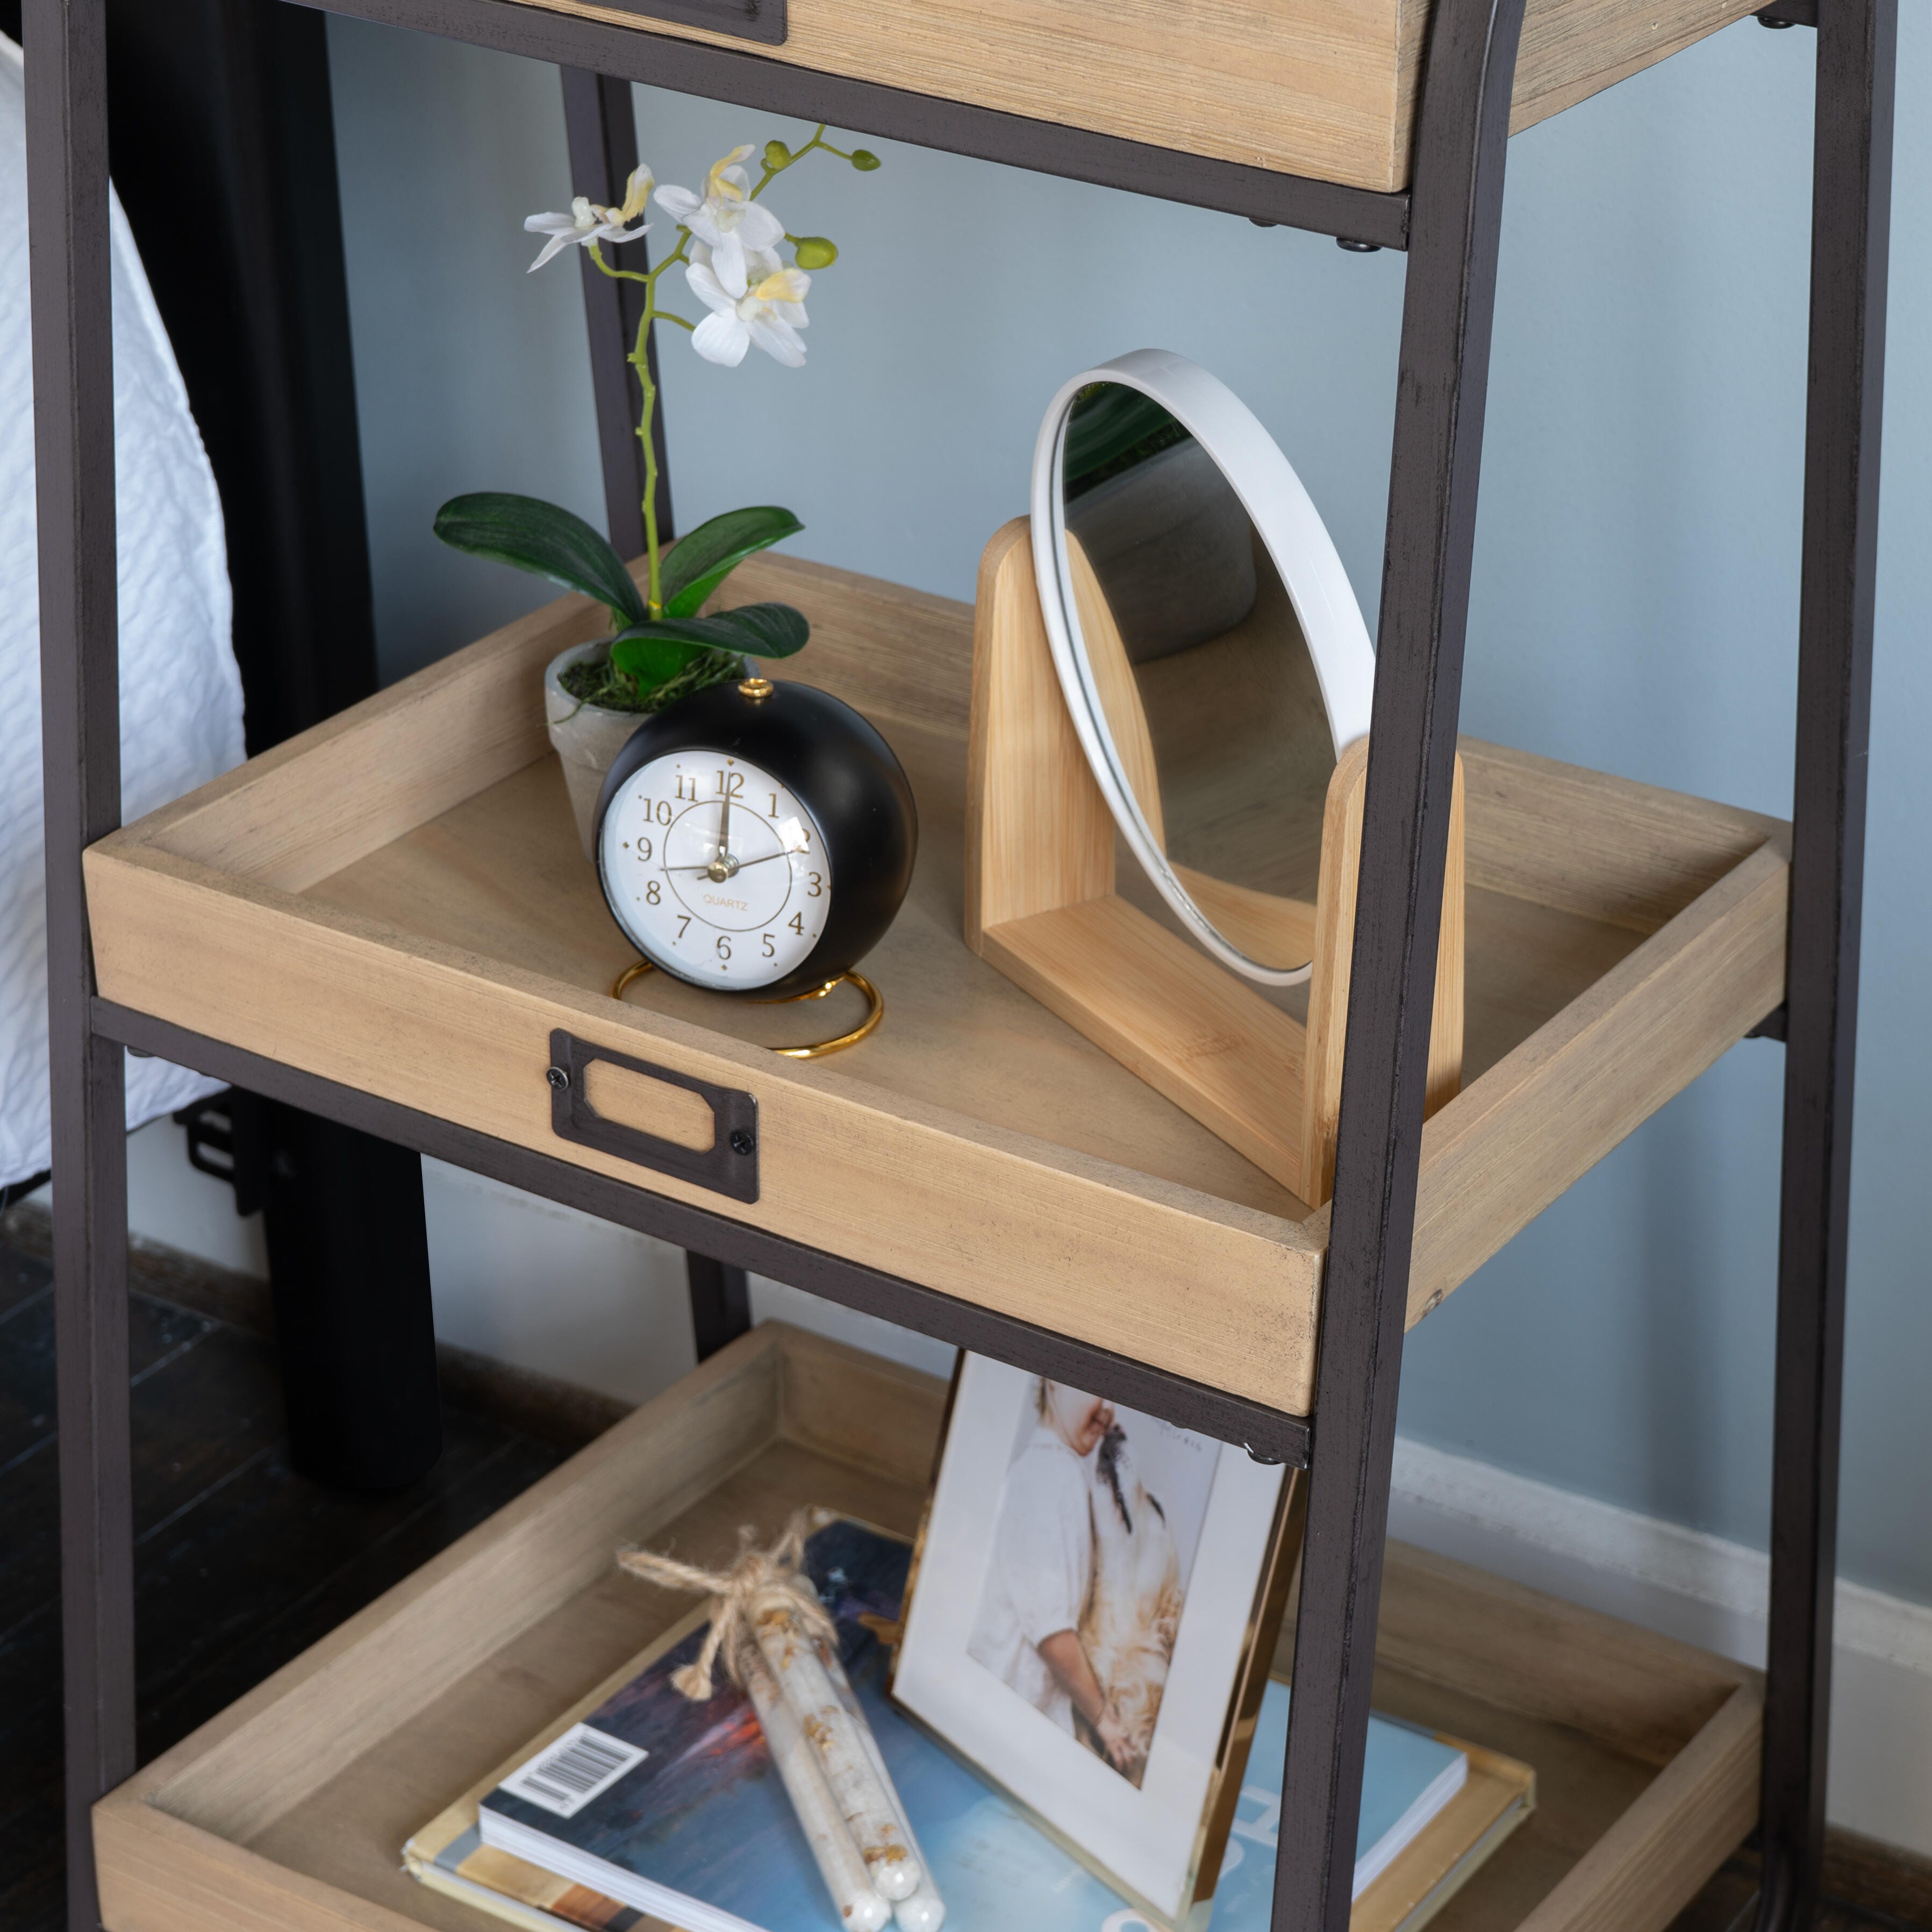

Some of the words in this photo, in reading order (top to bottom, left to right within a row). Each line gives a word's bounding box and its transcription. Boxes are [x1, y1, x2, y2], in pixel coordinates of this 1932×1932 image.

[675, 775, 699, 802] 11
[715, 770, 745, 799] 12
[643, 798, 672, 826] 10
[768, 793, 779, 818] 1
[637, 837, 652, 862] 9
[646, 881, 661, 905] 8
[807, 871, 822, 897] 3
[703, 893, 748, 912] QUARTZ
[677, 914, 691, 939] 7
[788, 911, 805, 935] 4
[717, 936, 732, 960] 6
[762, 933, 776, 957] 5
